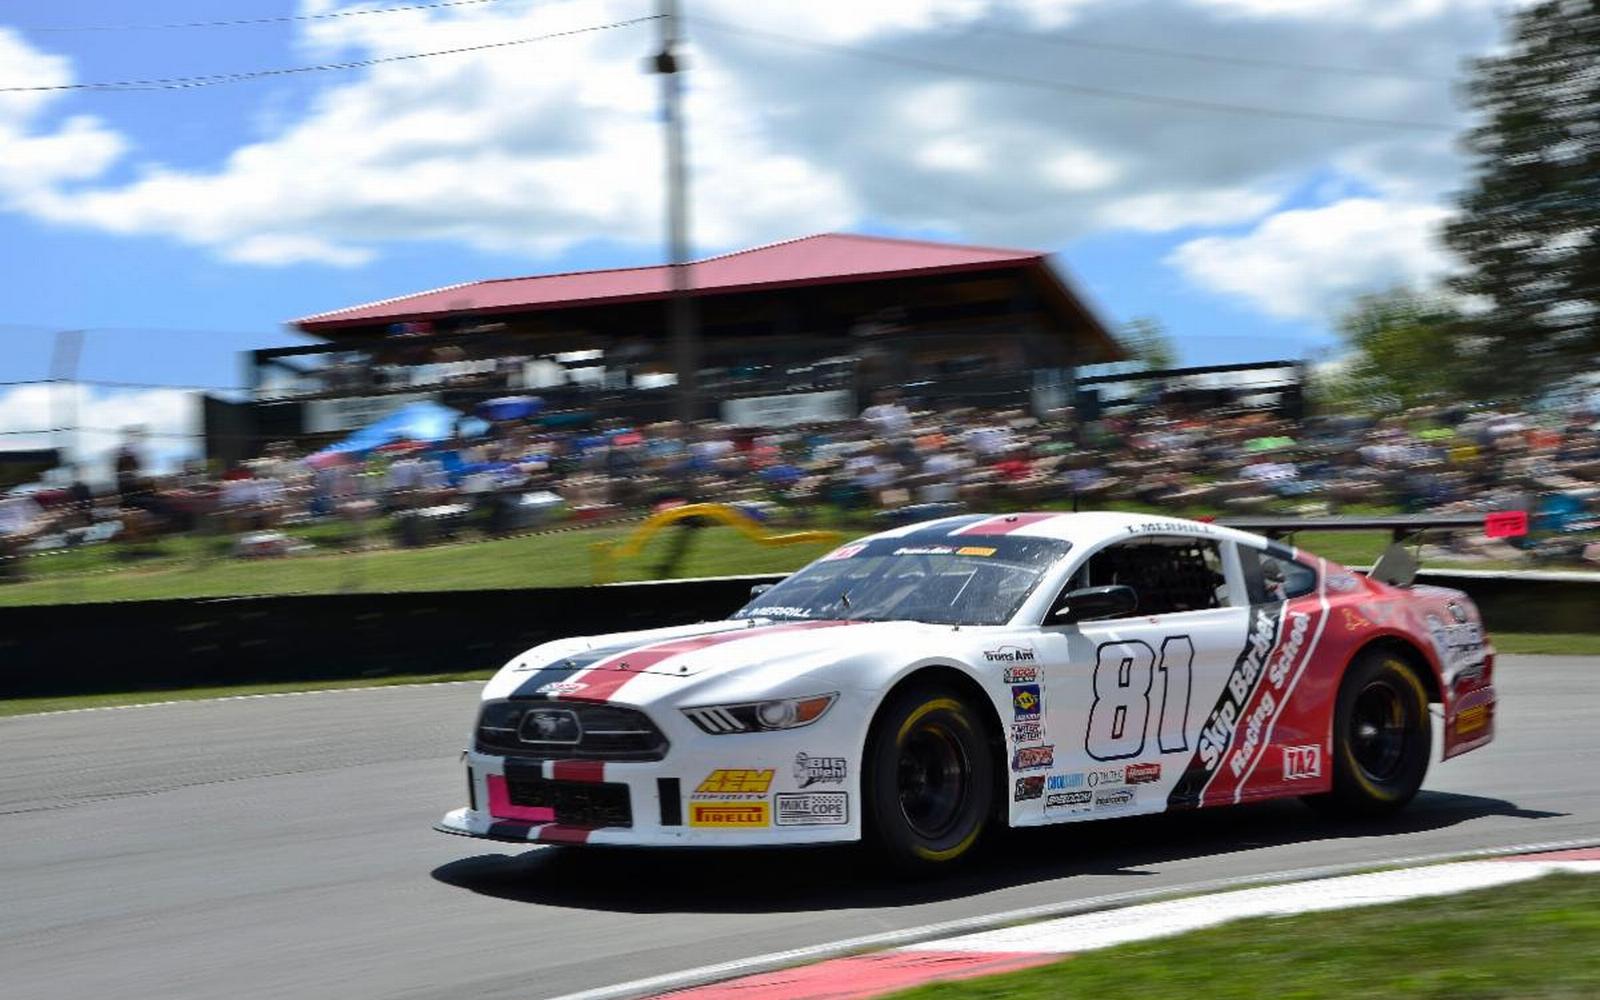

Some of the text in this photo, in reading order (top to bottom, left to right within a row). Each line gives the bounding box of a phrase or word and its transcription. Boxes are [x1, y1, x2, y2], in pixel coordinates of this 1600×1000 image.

[1085, 635, 1194, 762] 81
[1200, 608, 1275, 771] Skip Barber
[1230, 610, 1310, 777] Racing School
[810, 757, 847, 768] BIG
[694, 769, 776, 793] AEM
[695, 806, 763, 823] PIRELLI
[780, 800, 842, 814] MIKE COPE
